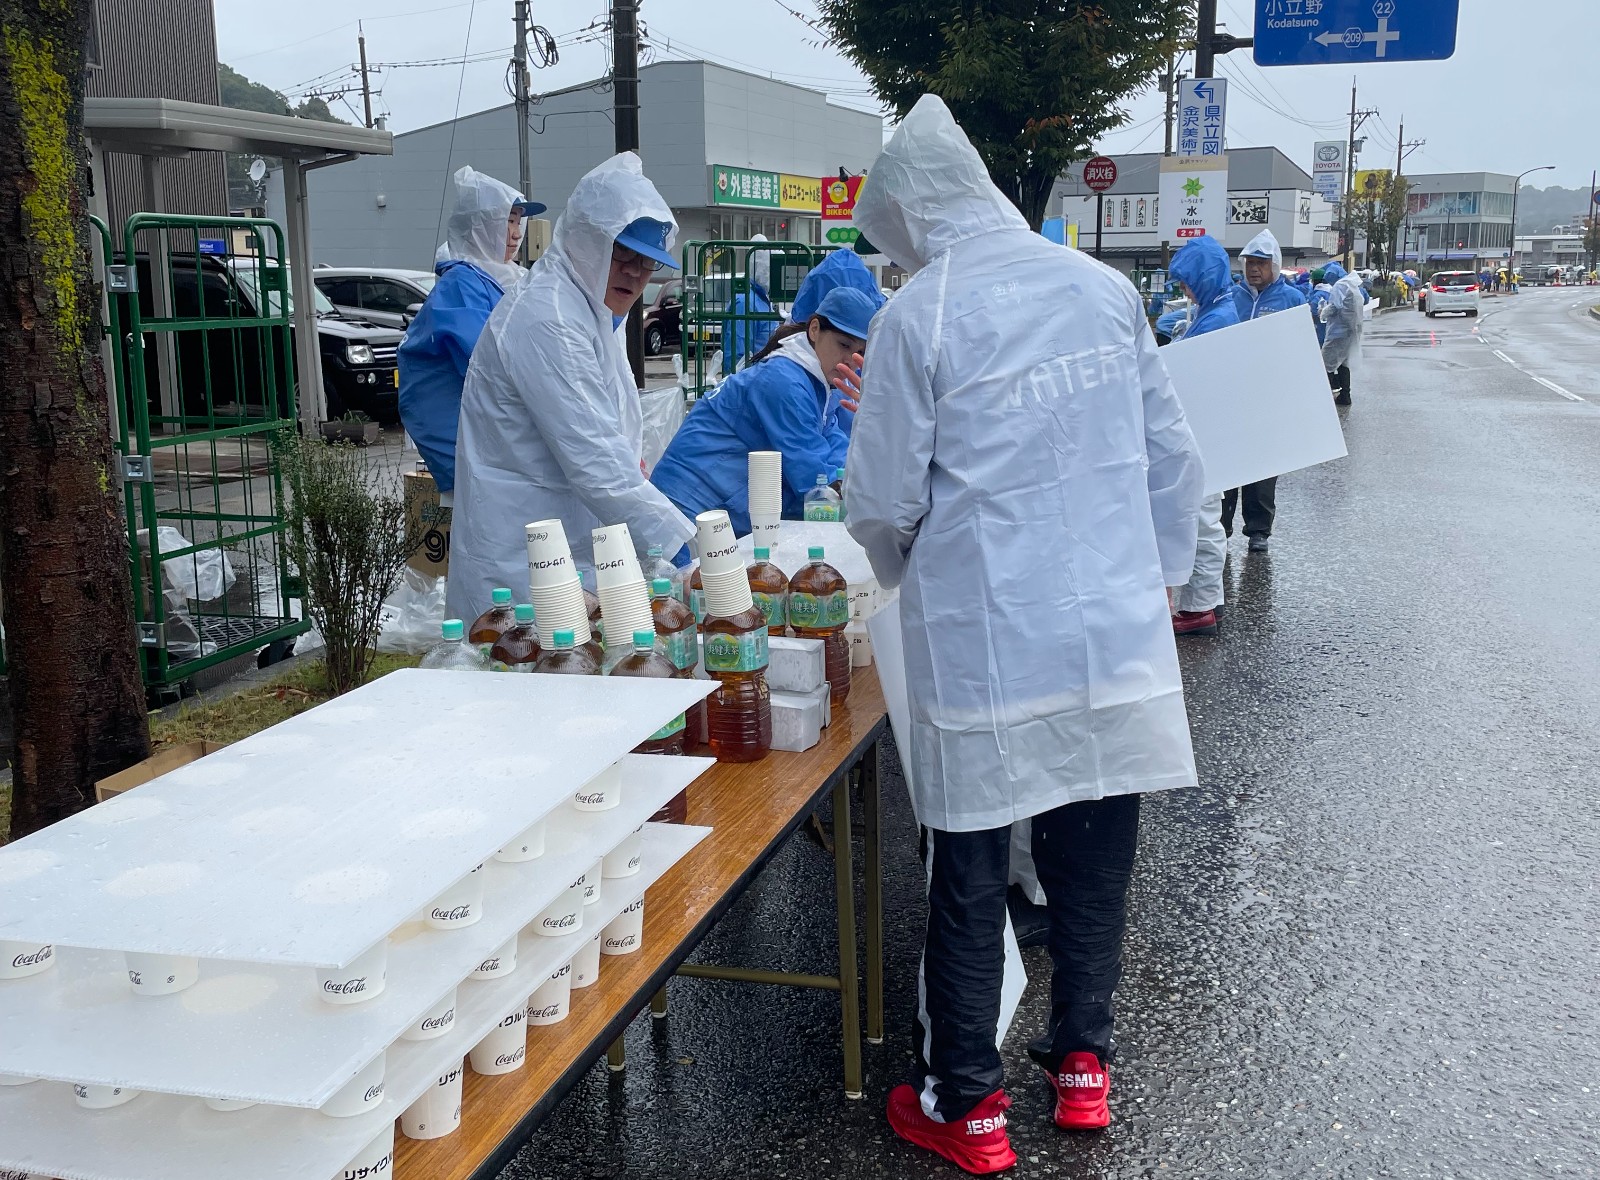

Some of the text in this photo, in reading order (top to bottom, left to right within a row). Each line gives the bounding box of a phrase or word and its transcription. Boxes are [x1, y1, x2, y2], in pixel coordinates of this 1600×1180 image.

[1265, 0, 1323, 16] 小立野
[1376, 2, 1391, 14] 22
[1267, 18, 1319, 29] Kodatsuno
[1345, 32, 1361, 43] 209
[1086, 166, 1114, 180] 消火栓
[730, 172, 772, 200] 外壁塗装
[1186, 205, 1198, 217] 水
[1180, 218, 1203, 226] Water
